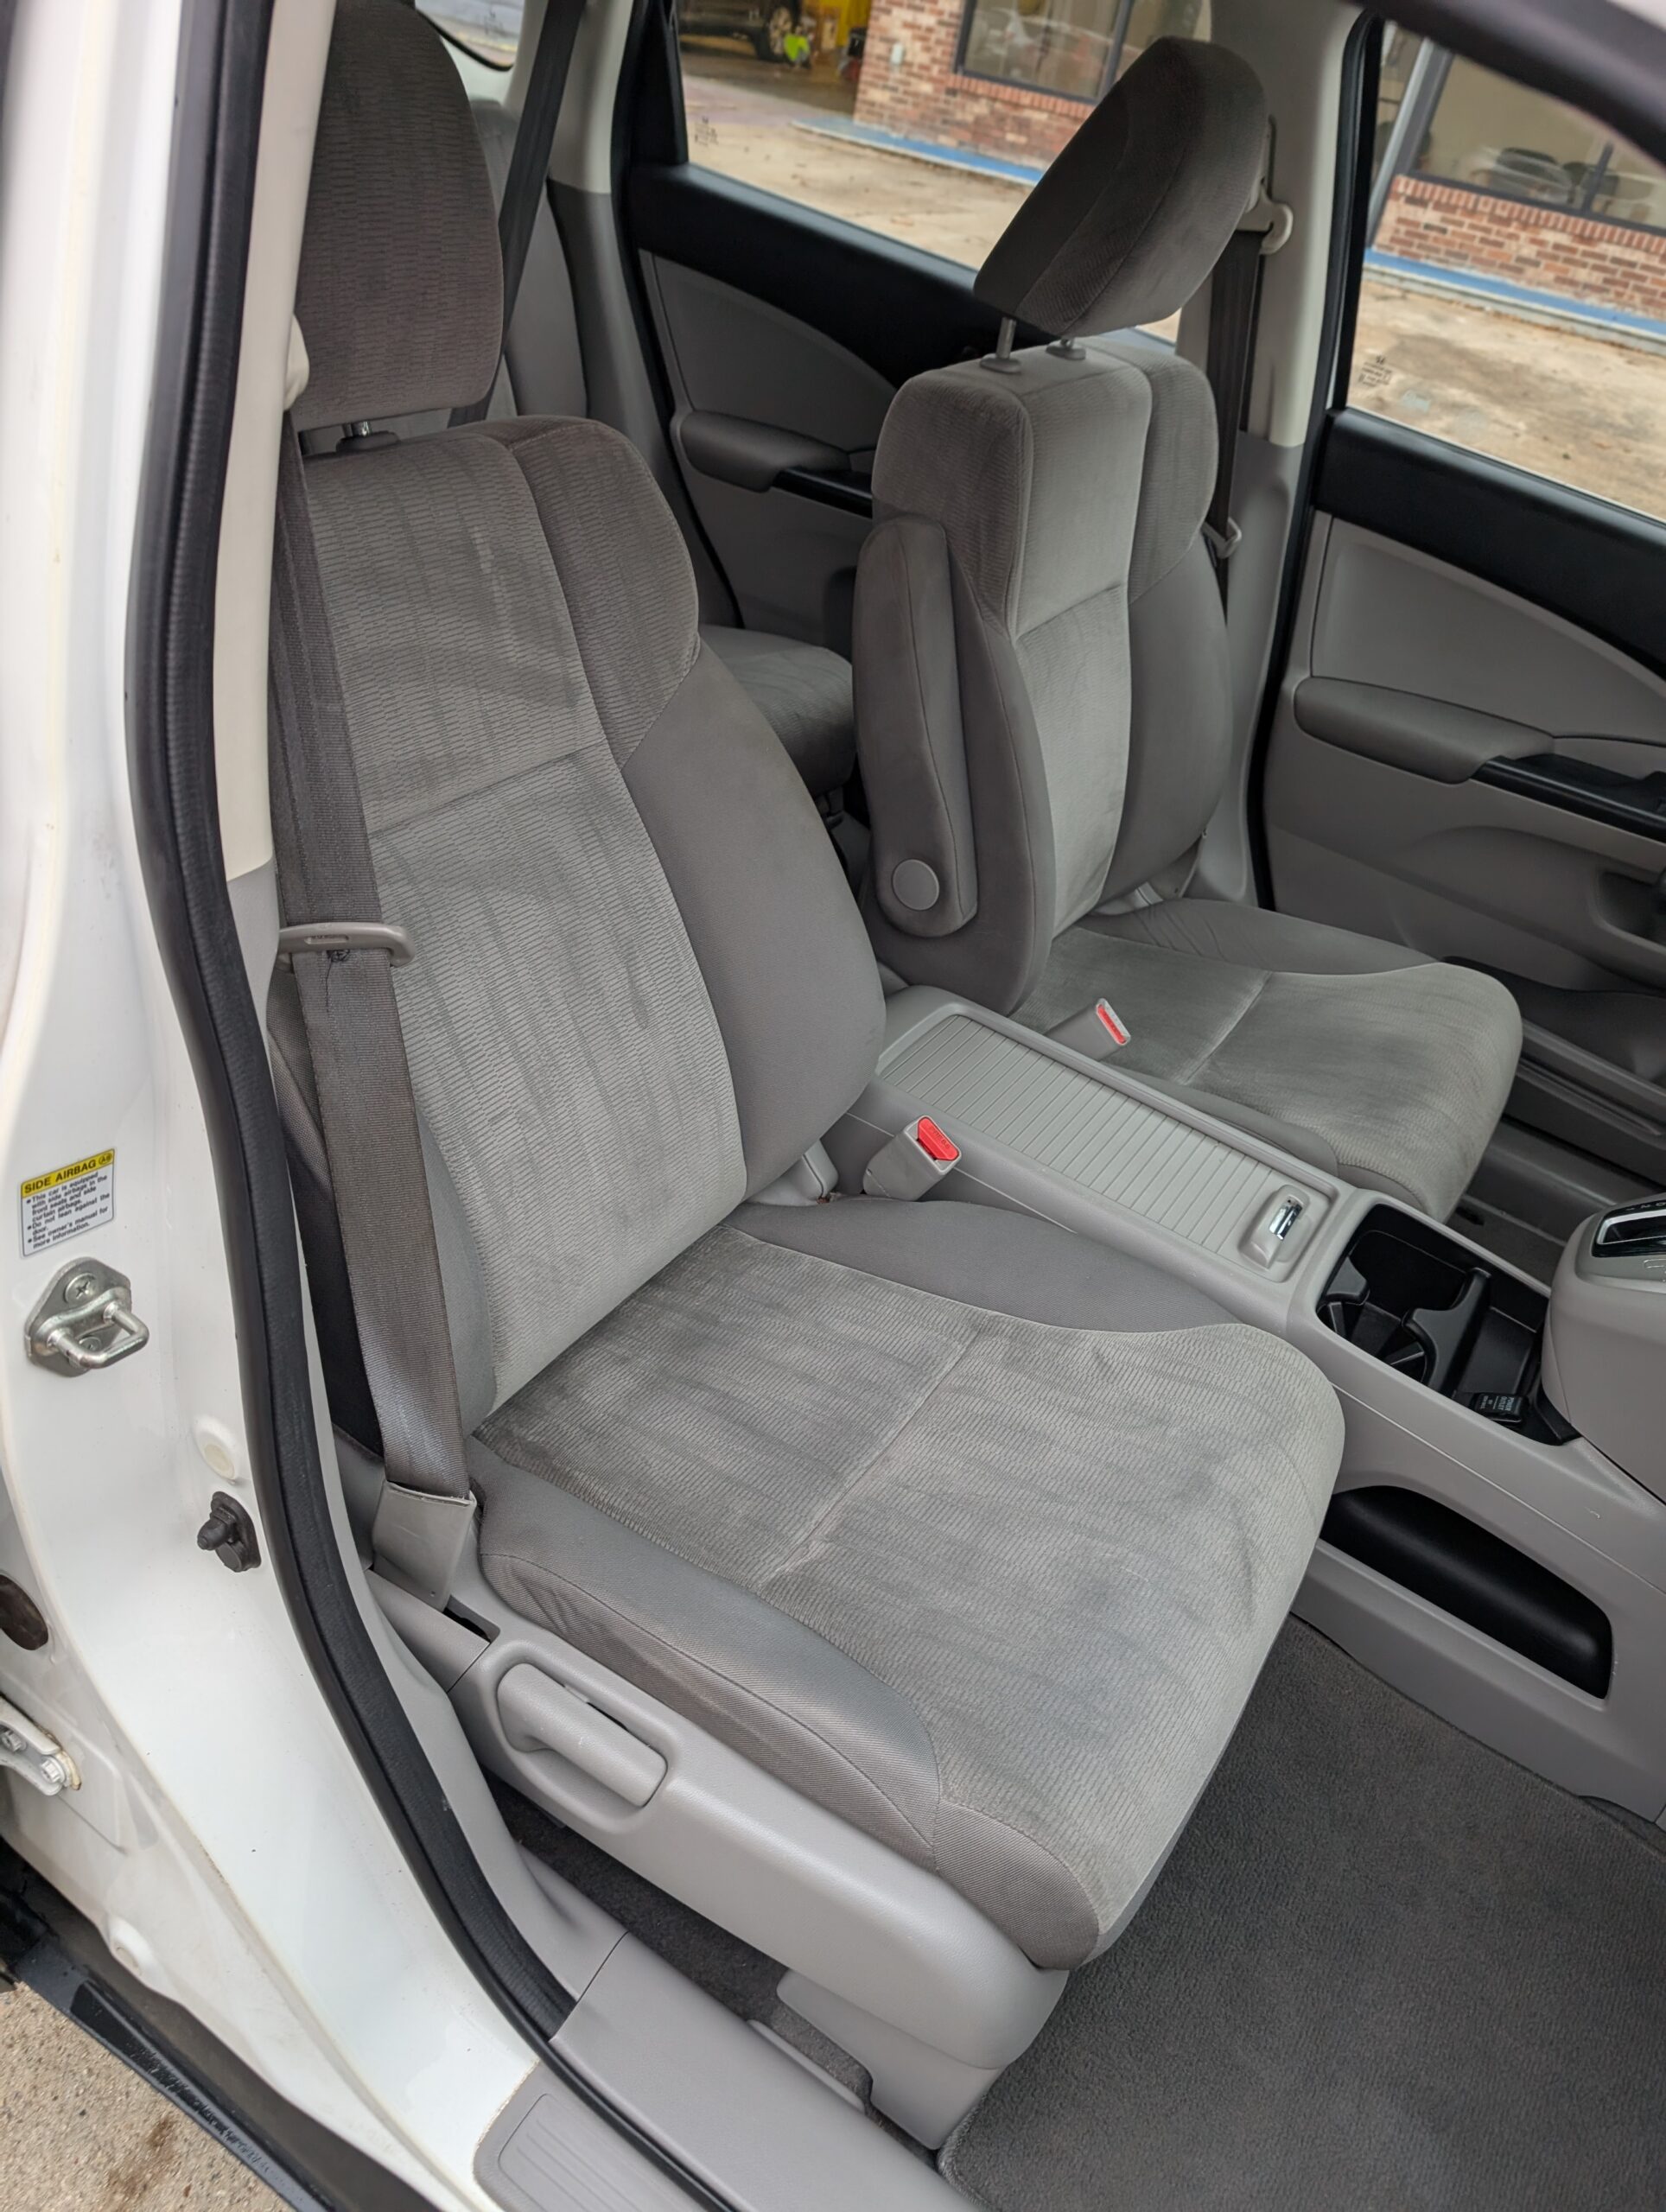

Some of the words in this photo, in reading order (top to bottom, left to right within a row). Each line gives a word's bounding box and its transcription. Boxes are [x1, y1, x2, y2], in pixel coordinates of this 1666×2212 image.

[24, 1176, 52, 1193] SIDE
[55, 1159, 96, 1182] AIRBAG
[32, 1193, 46, 1203] This
[48, 1188, 60, 1197] car
[69, 1171, 99, 1187] equipped
[32, 1199, 47, 1209] with
[48, 1193, 61, 1203] side
[64, 1184, 87, 1197] airbags
[32, 1205, 48, 1216] front
[50, 1198, 67, 1208] seats
[69, 1191, 81, 1201] and
[84, 1185, 96, 1196] side
[32, 1210, 55, 1222] curtain
[58, 1199, 82, 1212] airbags.
[44, 1215, 55, 1224] not
[58, 1210, 72, 1218] lean
[74, 1197, 97, 1211] against
[99, 1192, 110, 1202] the
[33, 1234, 46, 1243] See
[48, 1222, 73, 1236] owner's
[74, 1210, 98, 1224] manual
[99, 1205, 108, 1214] for
[33, 1226, 48, 1236] door.
[33, 1238, 51, 1249] more
[52, 1222, 90, 1241] information.
